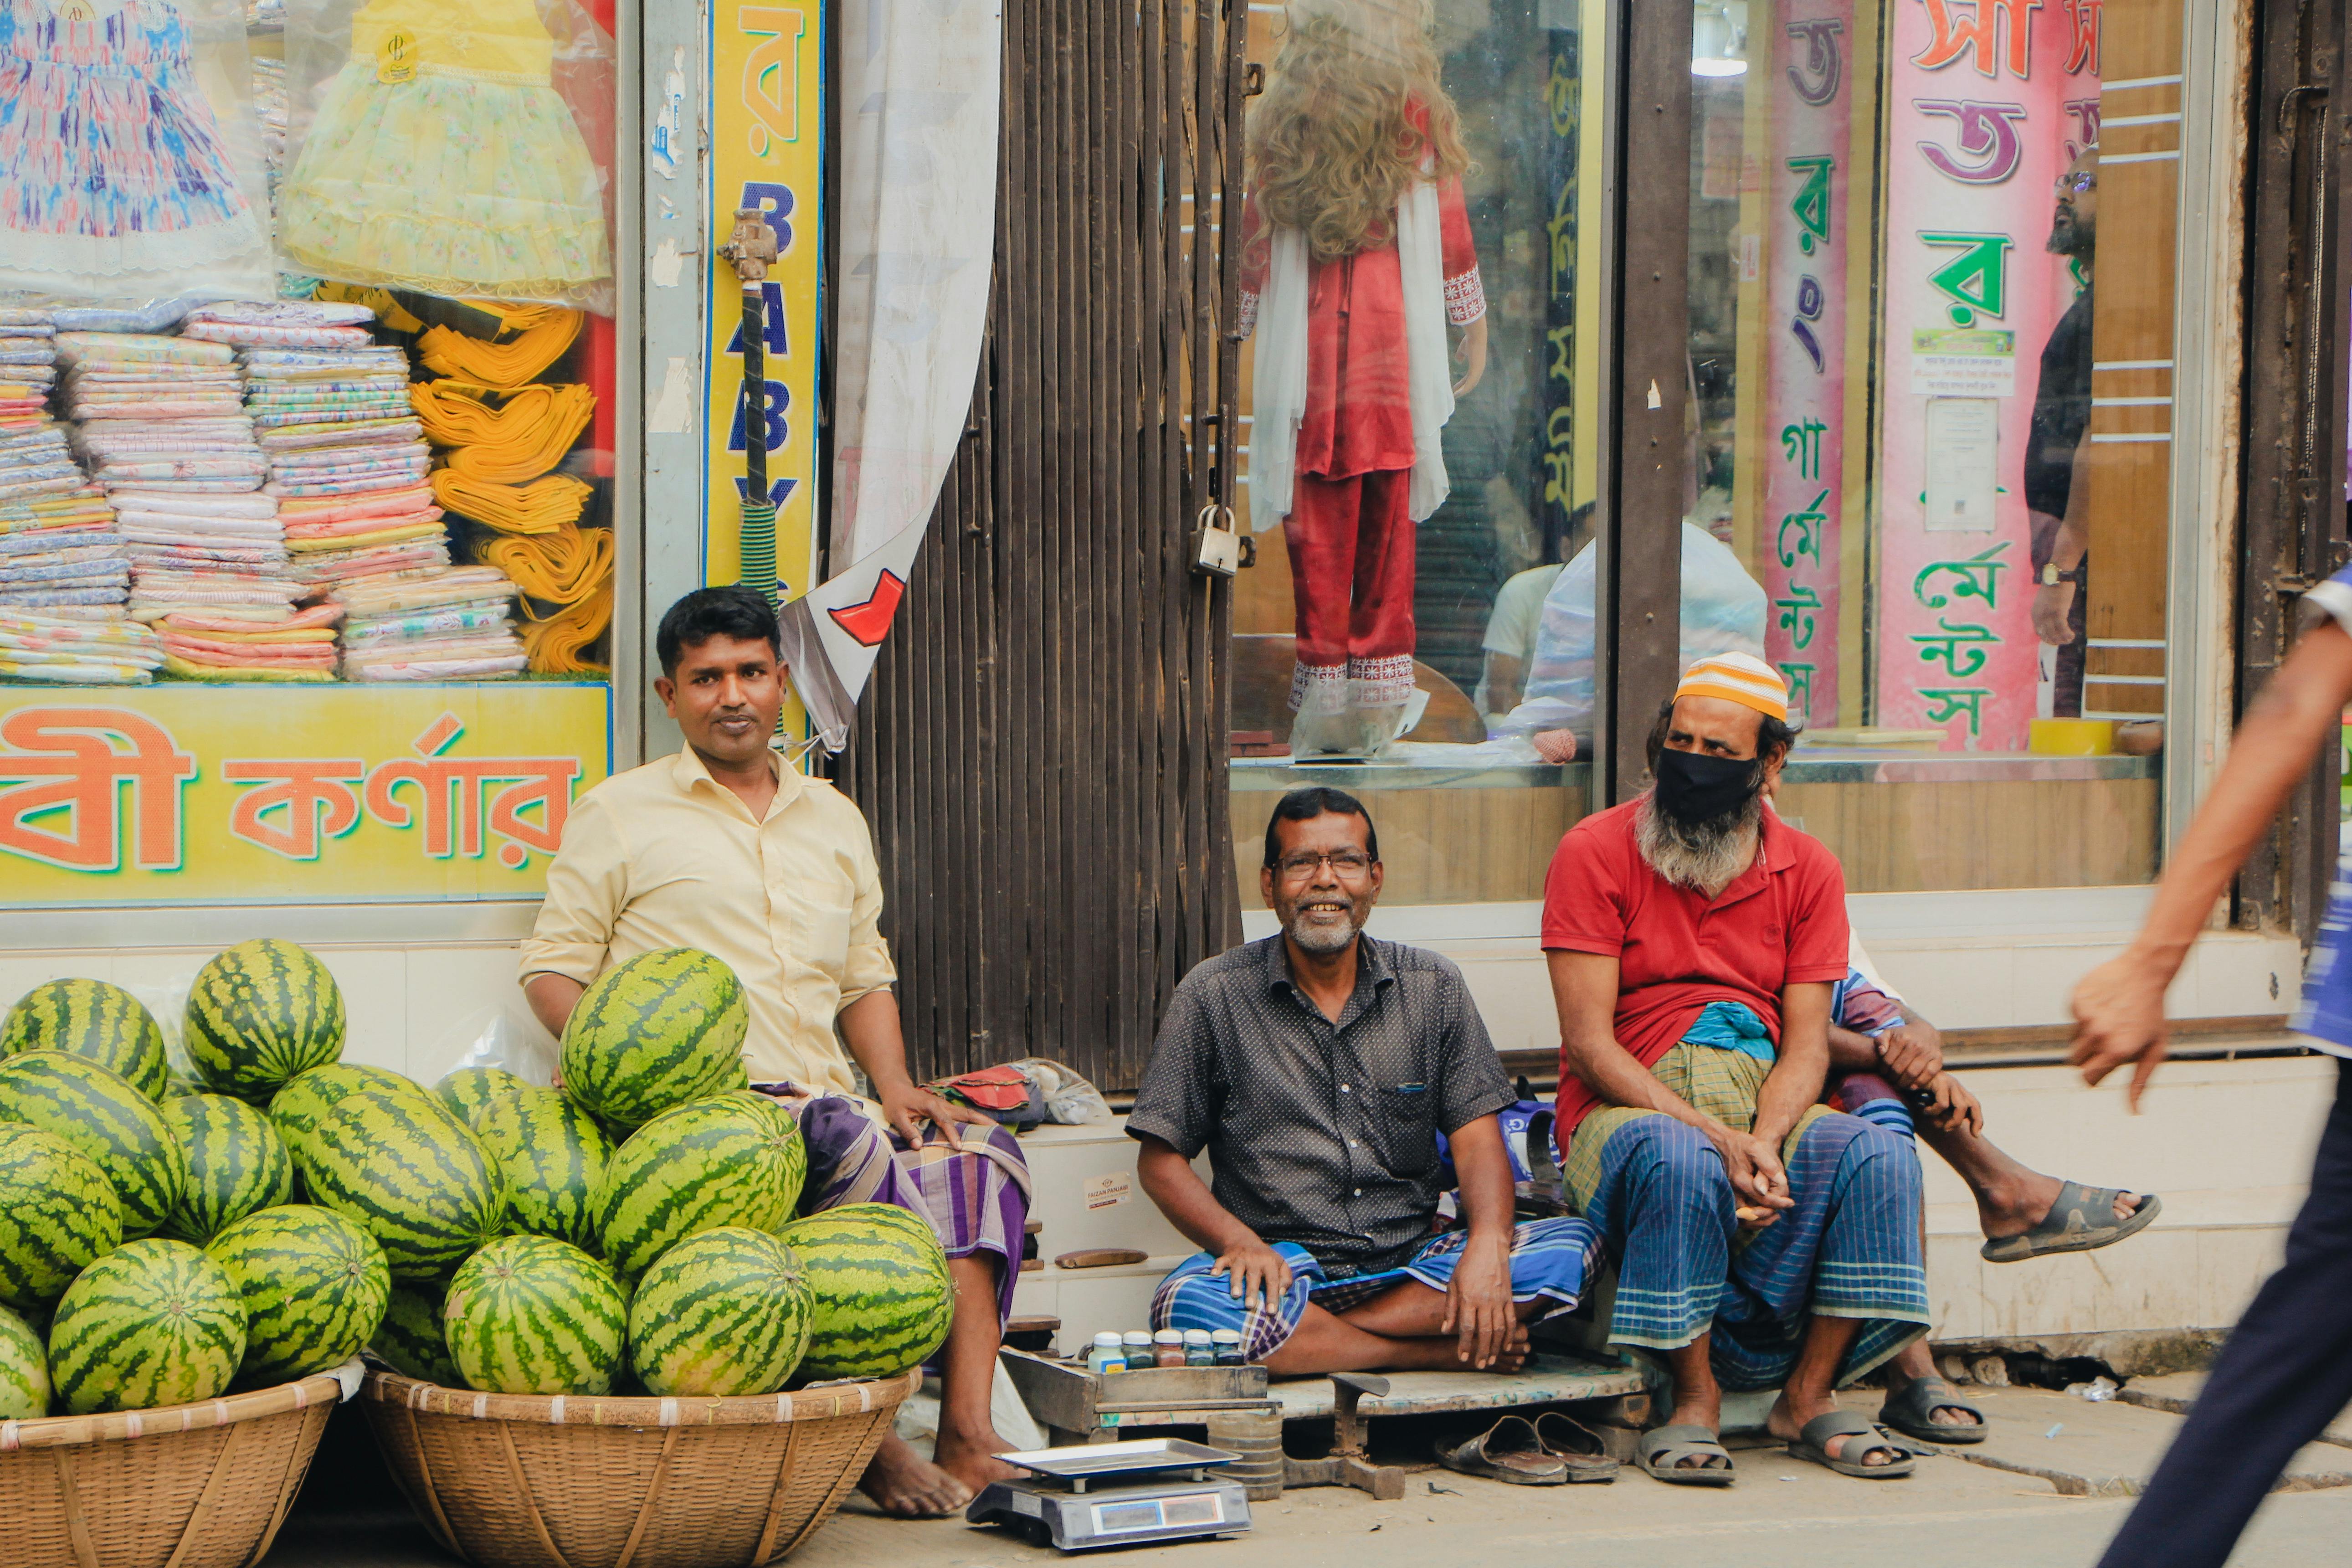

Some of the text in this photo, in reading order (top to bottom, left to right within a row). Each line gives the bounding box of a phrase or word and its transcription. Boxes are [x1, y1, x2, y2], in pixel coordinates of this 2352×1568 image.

[1909, 0, 2042, 328] সাতর
[1908, 541, 2012, 735] র্মেন্টস
[221, 711, 582, 869] কর্ণার
[1088, 1189, 1106, 1198] FAIZAN
[1107, 1184, 1128, 1193] PANJABI
